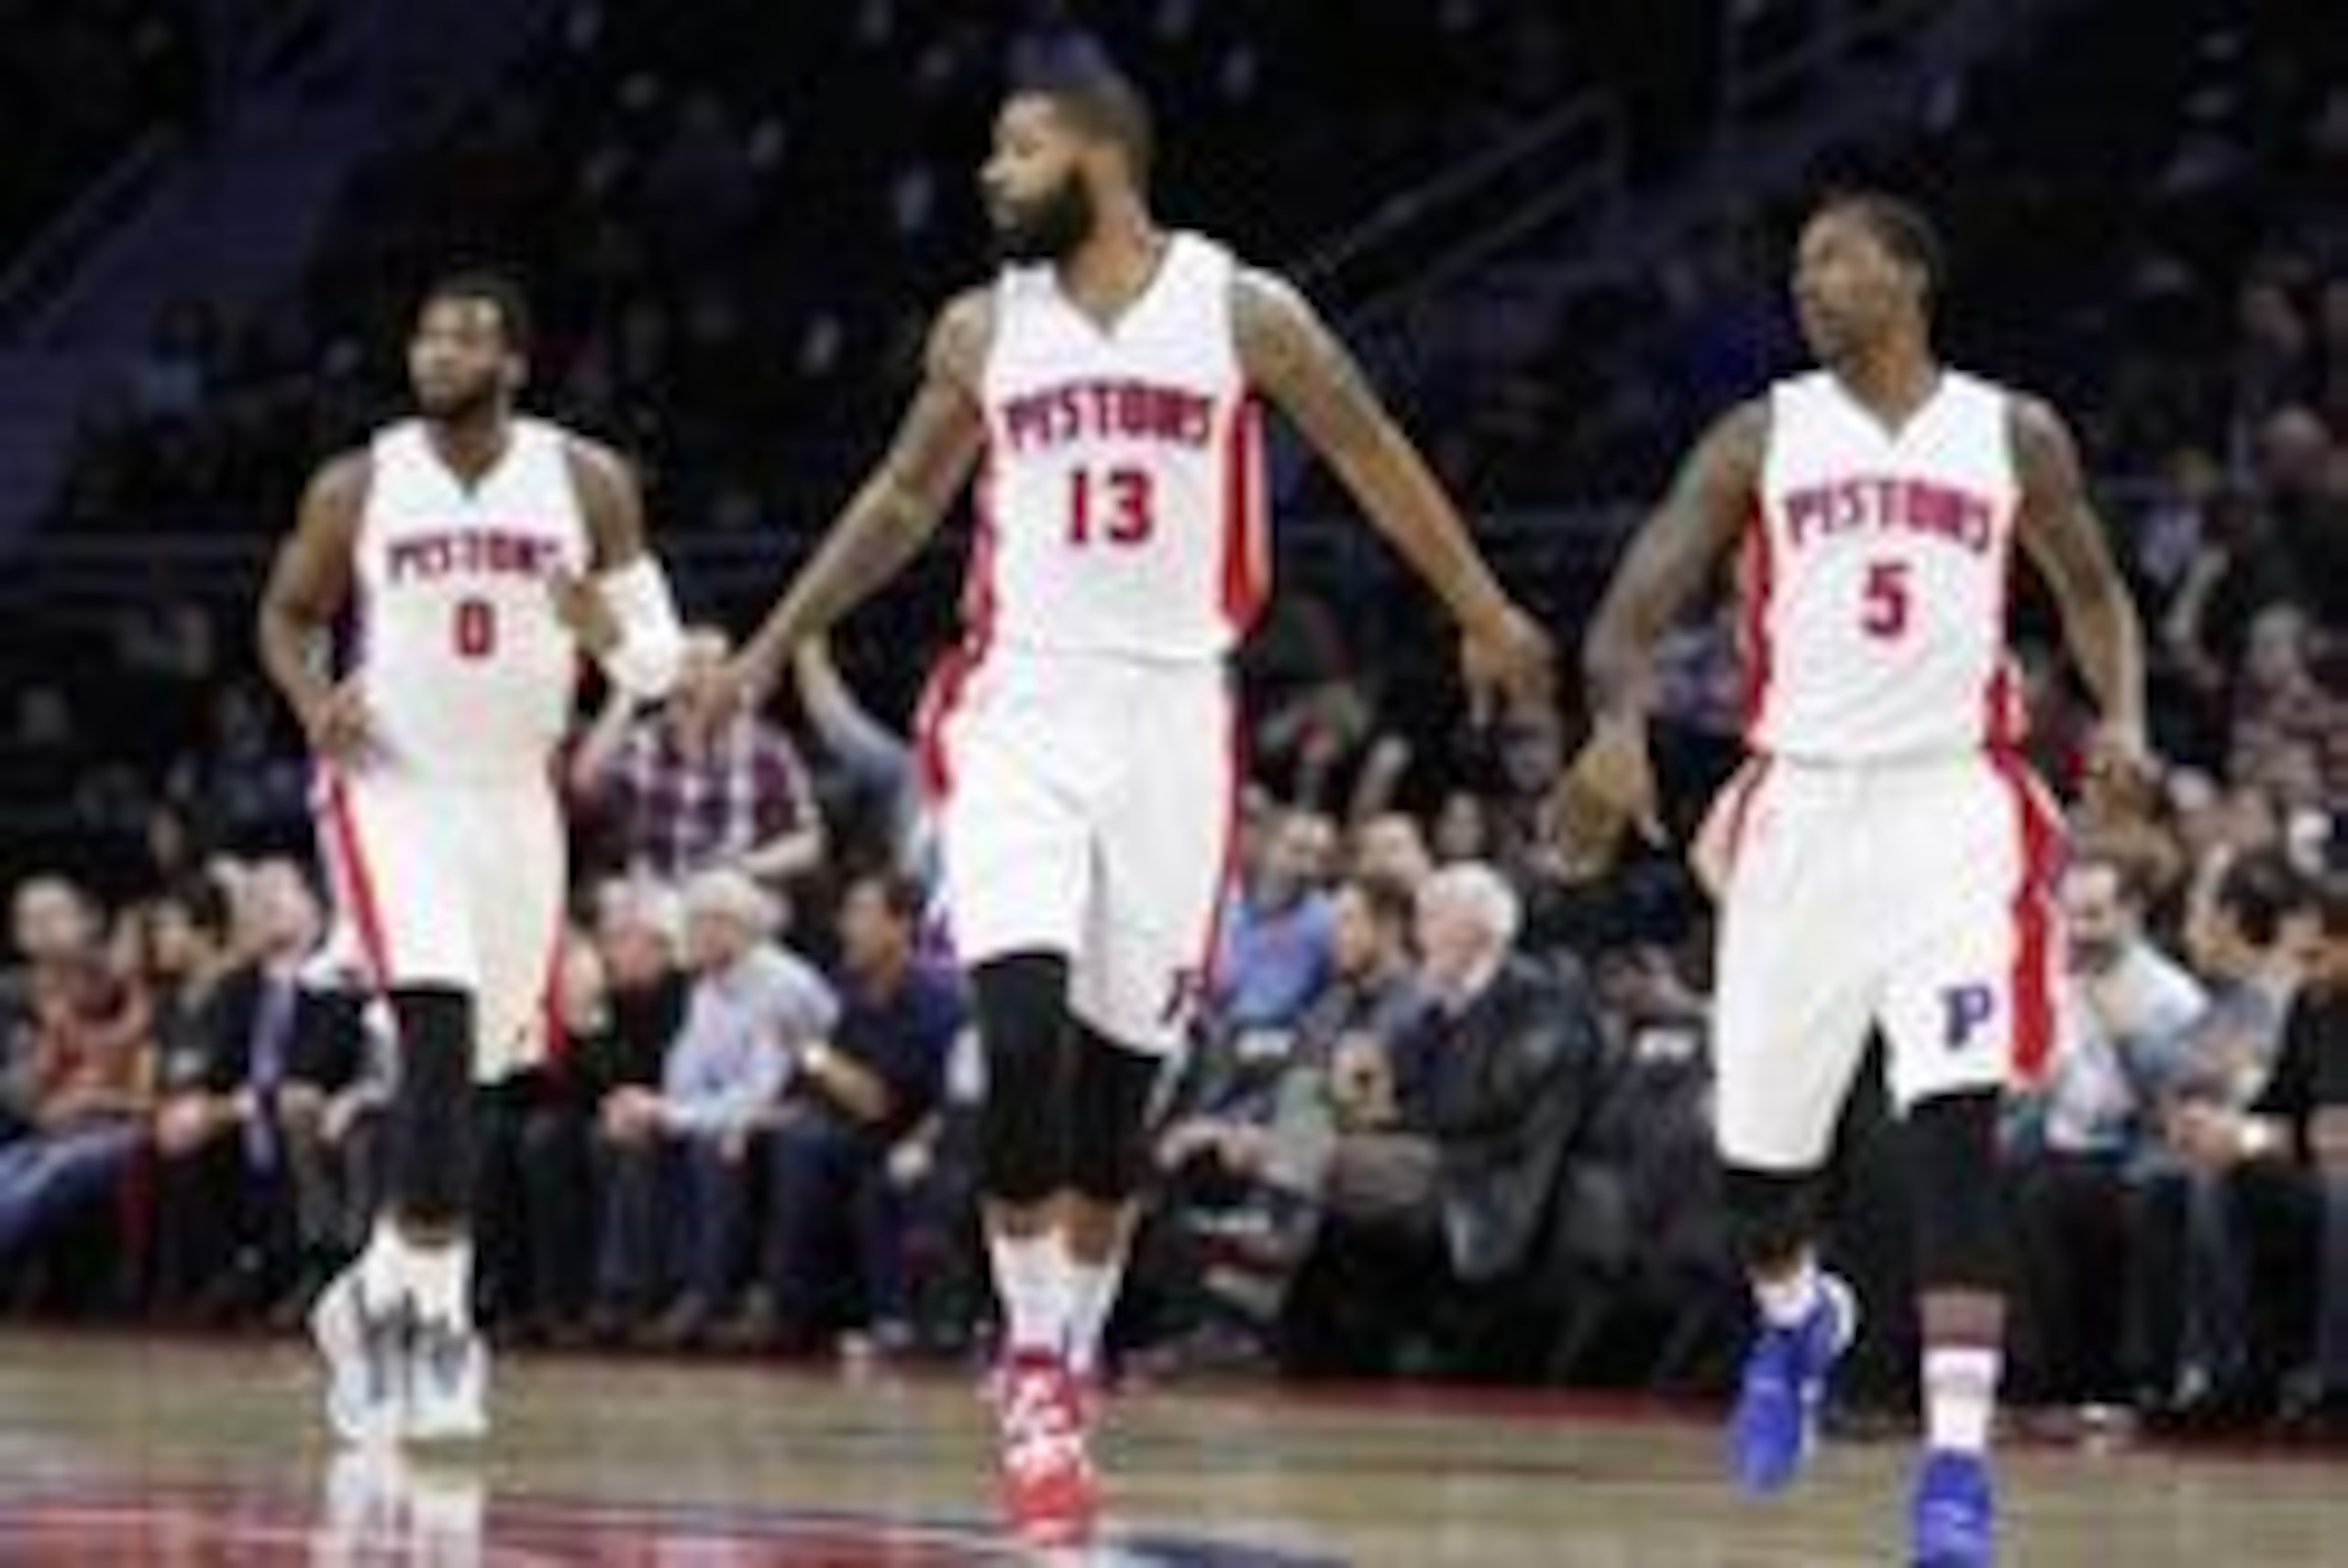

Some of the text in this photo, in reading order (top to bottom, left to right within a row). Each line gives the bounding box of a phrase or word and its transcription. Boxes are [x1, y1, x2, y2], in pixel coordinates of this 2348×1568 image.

[1002, 381, 1213, 448] PISTONS
[1066, 466, 1154, 544] 13
[1785, 479, 1990, 553] PISTONS
[458, 599, 495, 657] 0
[1863, 561, 1910, 638] 5
[1937, 984, 1991, 1051] P
